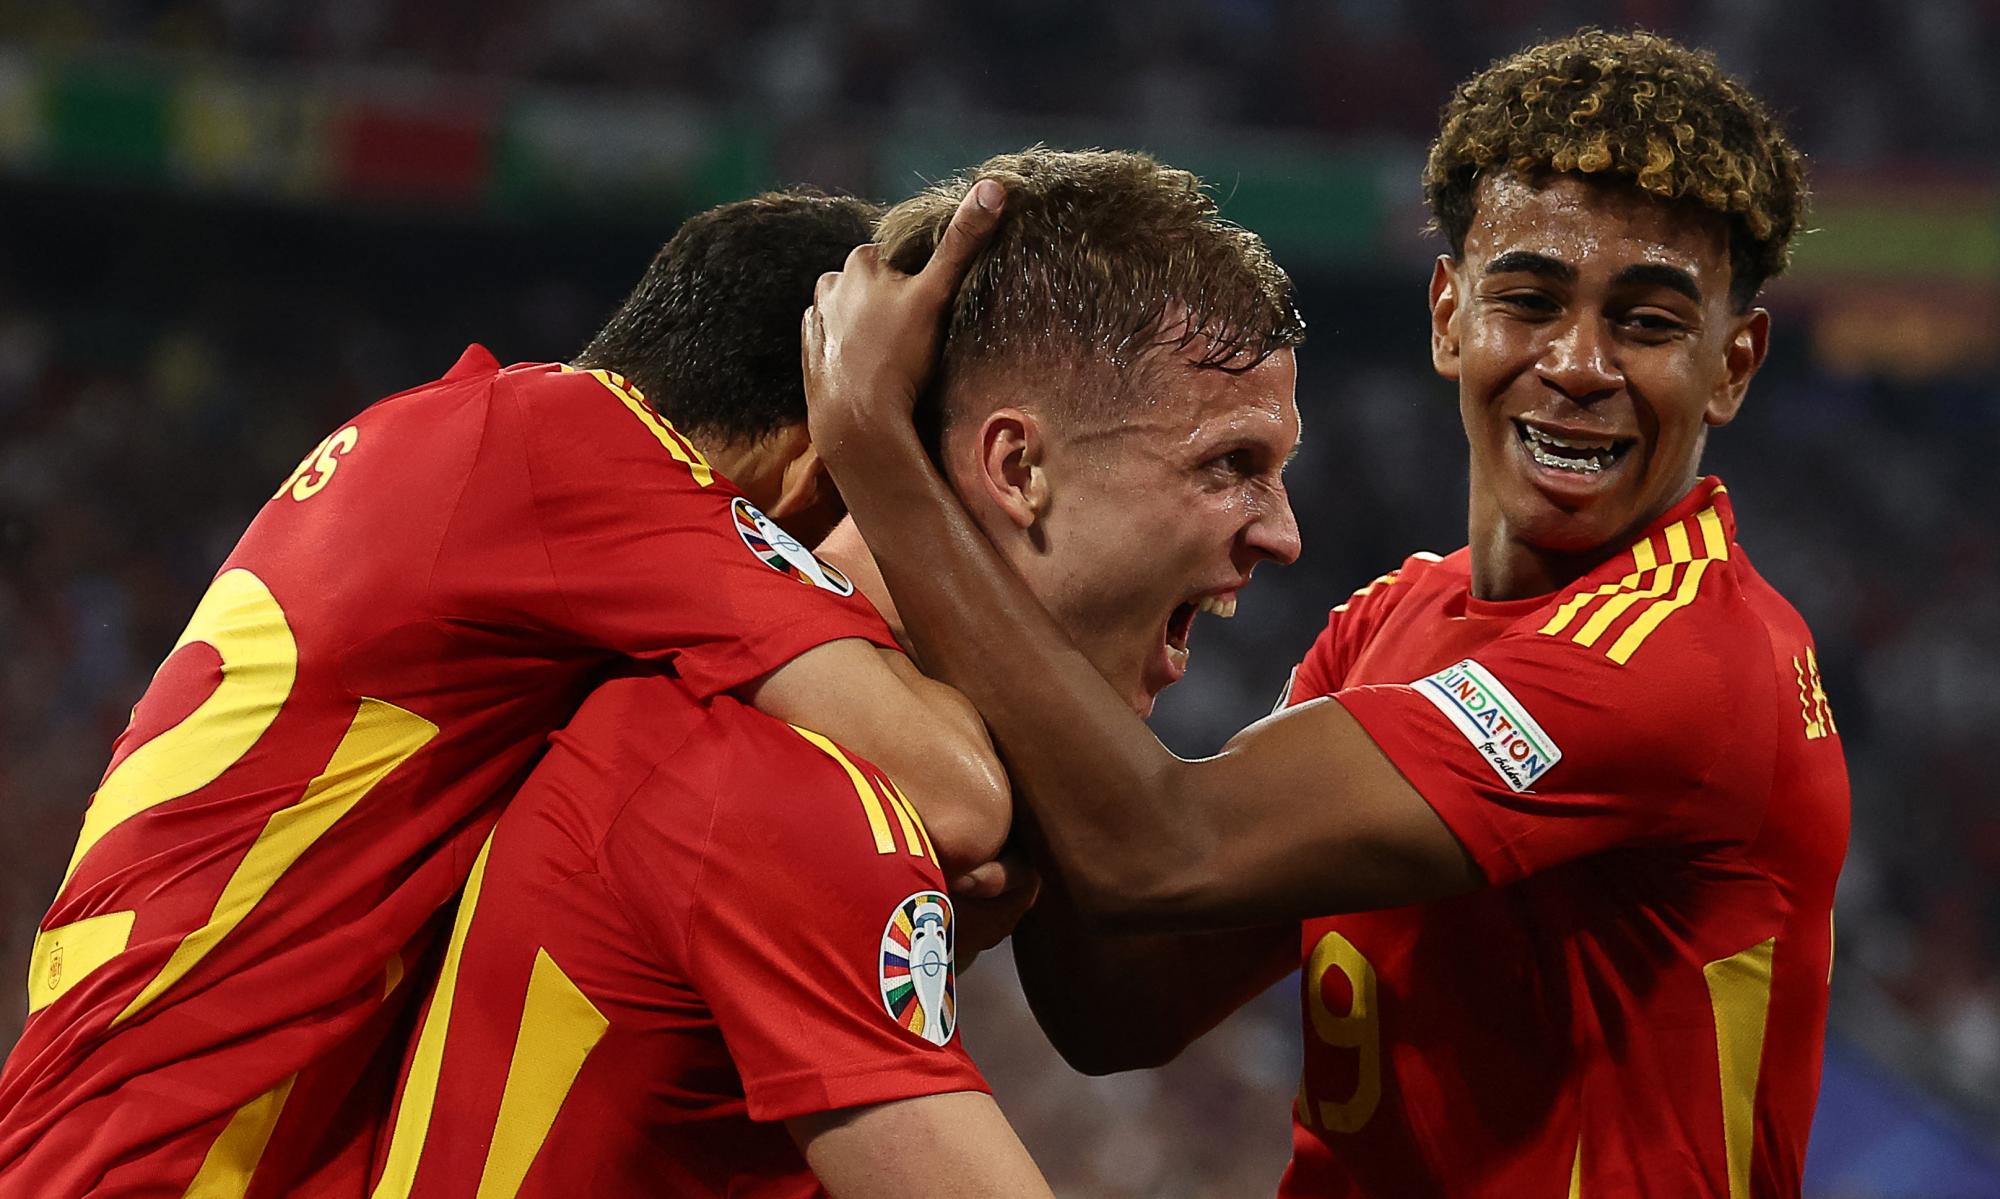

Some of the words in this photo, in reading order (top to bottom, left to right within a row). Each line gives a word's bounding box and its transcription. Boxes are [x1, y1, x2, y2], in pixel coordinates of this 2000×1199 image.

[27, 567, 298, 1016] 2
[1479, 741, 1497, 755] for
[1493, 757, 1523, 789] children
[1297, 930, 1382, 1134] 9
